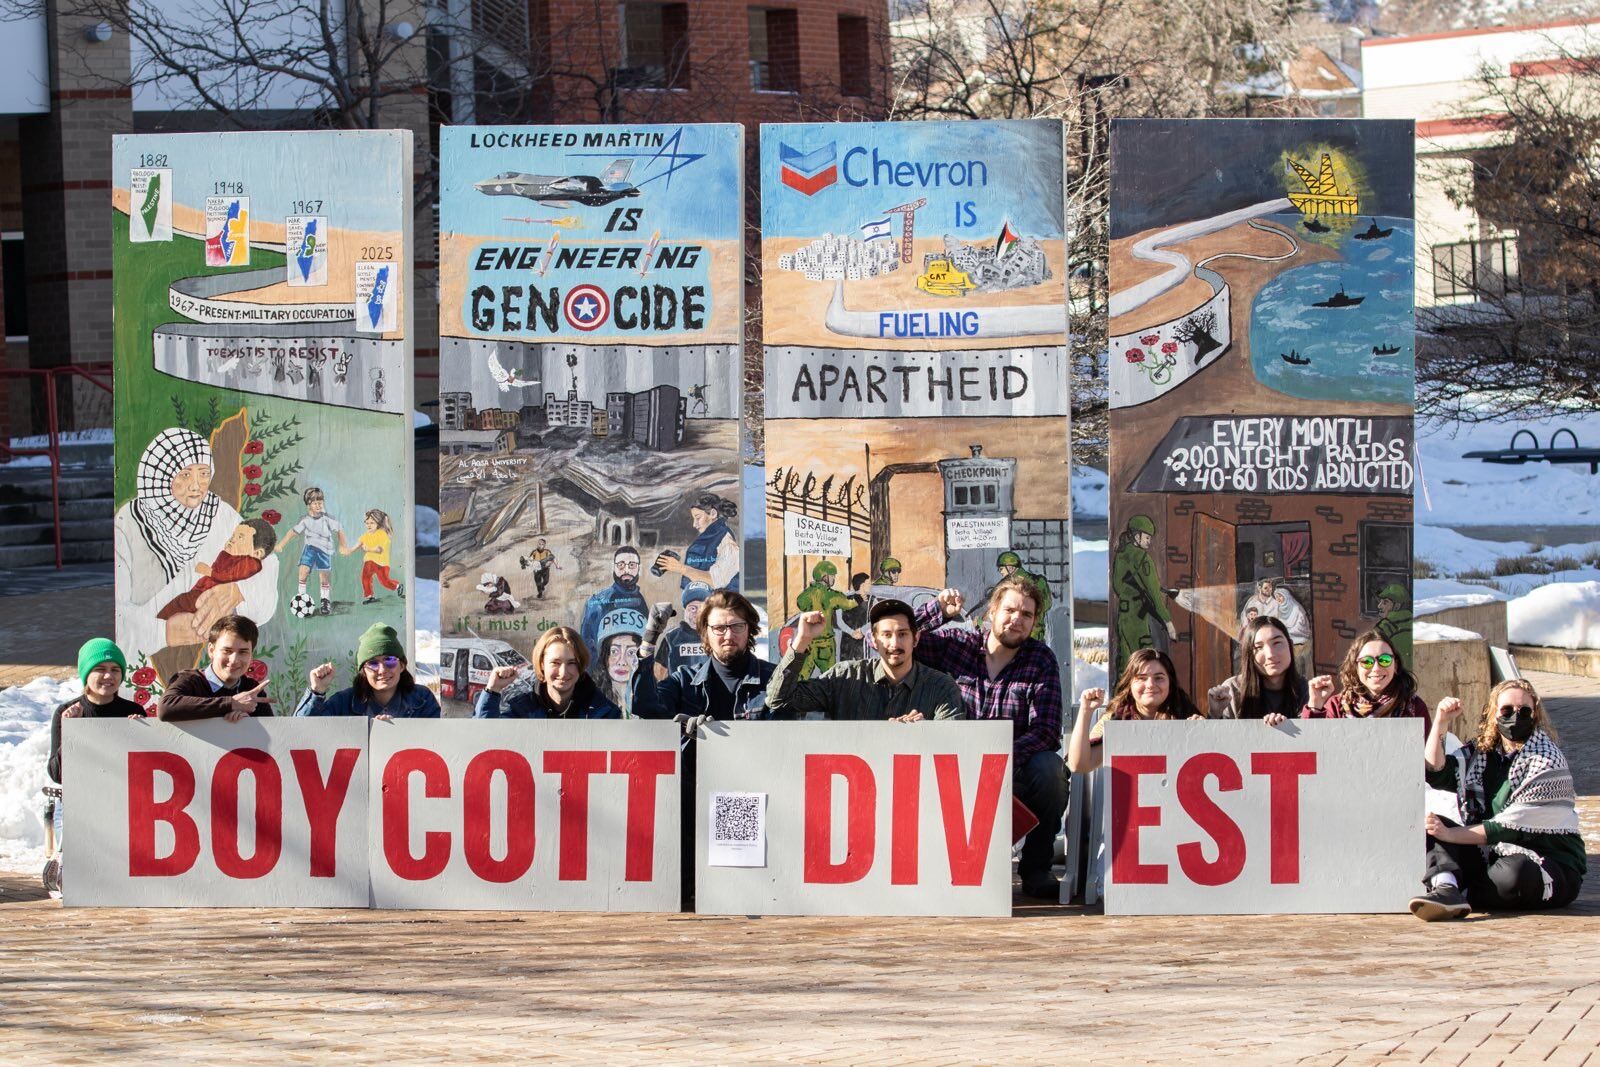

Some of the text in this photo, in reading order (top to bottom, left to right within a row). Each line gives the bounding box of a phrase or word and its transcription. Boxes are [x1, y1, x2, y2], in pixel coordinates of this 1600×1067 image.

[470, 132, 664, 148] LOCKHEED MARTIN
[140, 153, 168, 168] 1882
[842, 146, 987, 188] Chevron
[214, 181, 244, 195] 1948
[292, 200, 323, 215] 1967
[955, 201, 978, 228] IS
[603, 207, 644, 233] IS
[361, 246, 393, 260] 2025
[929, 273, 947, 281] CAT
[293, 308, 355, 320] OCCUPATION
[879, 311, 980, 337] FUELING
[206, 346, 340, 361] TO EXIST IS TO RESIST
[791, 363, 1029, 403] APARTHEID
[1213, 417, 1373, 447] EVERY MONTH
[1224, 445, 1312, 469] NIGHT
[1326, 438, 1406, 463] RAIDS
[946, 467, 1009, 480] CHECKPOINT
[1193, 467, 1258, 491] 40-60
[1267, 463, 1309, 491] KIDS
[1315, 460, 1414, 490] ABDUCTED
[797, 518, 843, 534] ISRAELIS:
[951, 520, 1004, 528] PALESTINIANS:
[456, 615, 470, 632] if
[489, 615, 529, 631] must
[602, 611, 645, 630] PRESS
[681, 646, 705, 655] PRES
[127, 747, 677, 884] BOYCOTT
